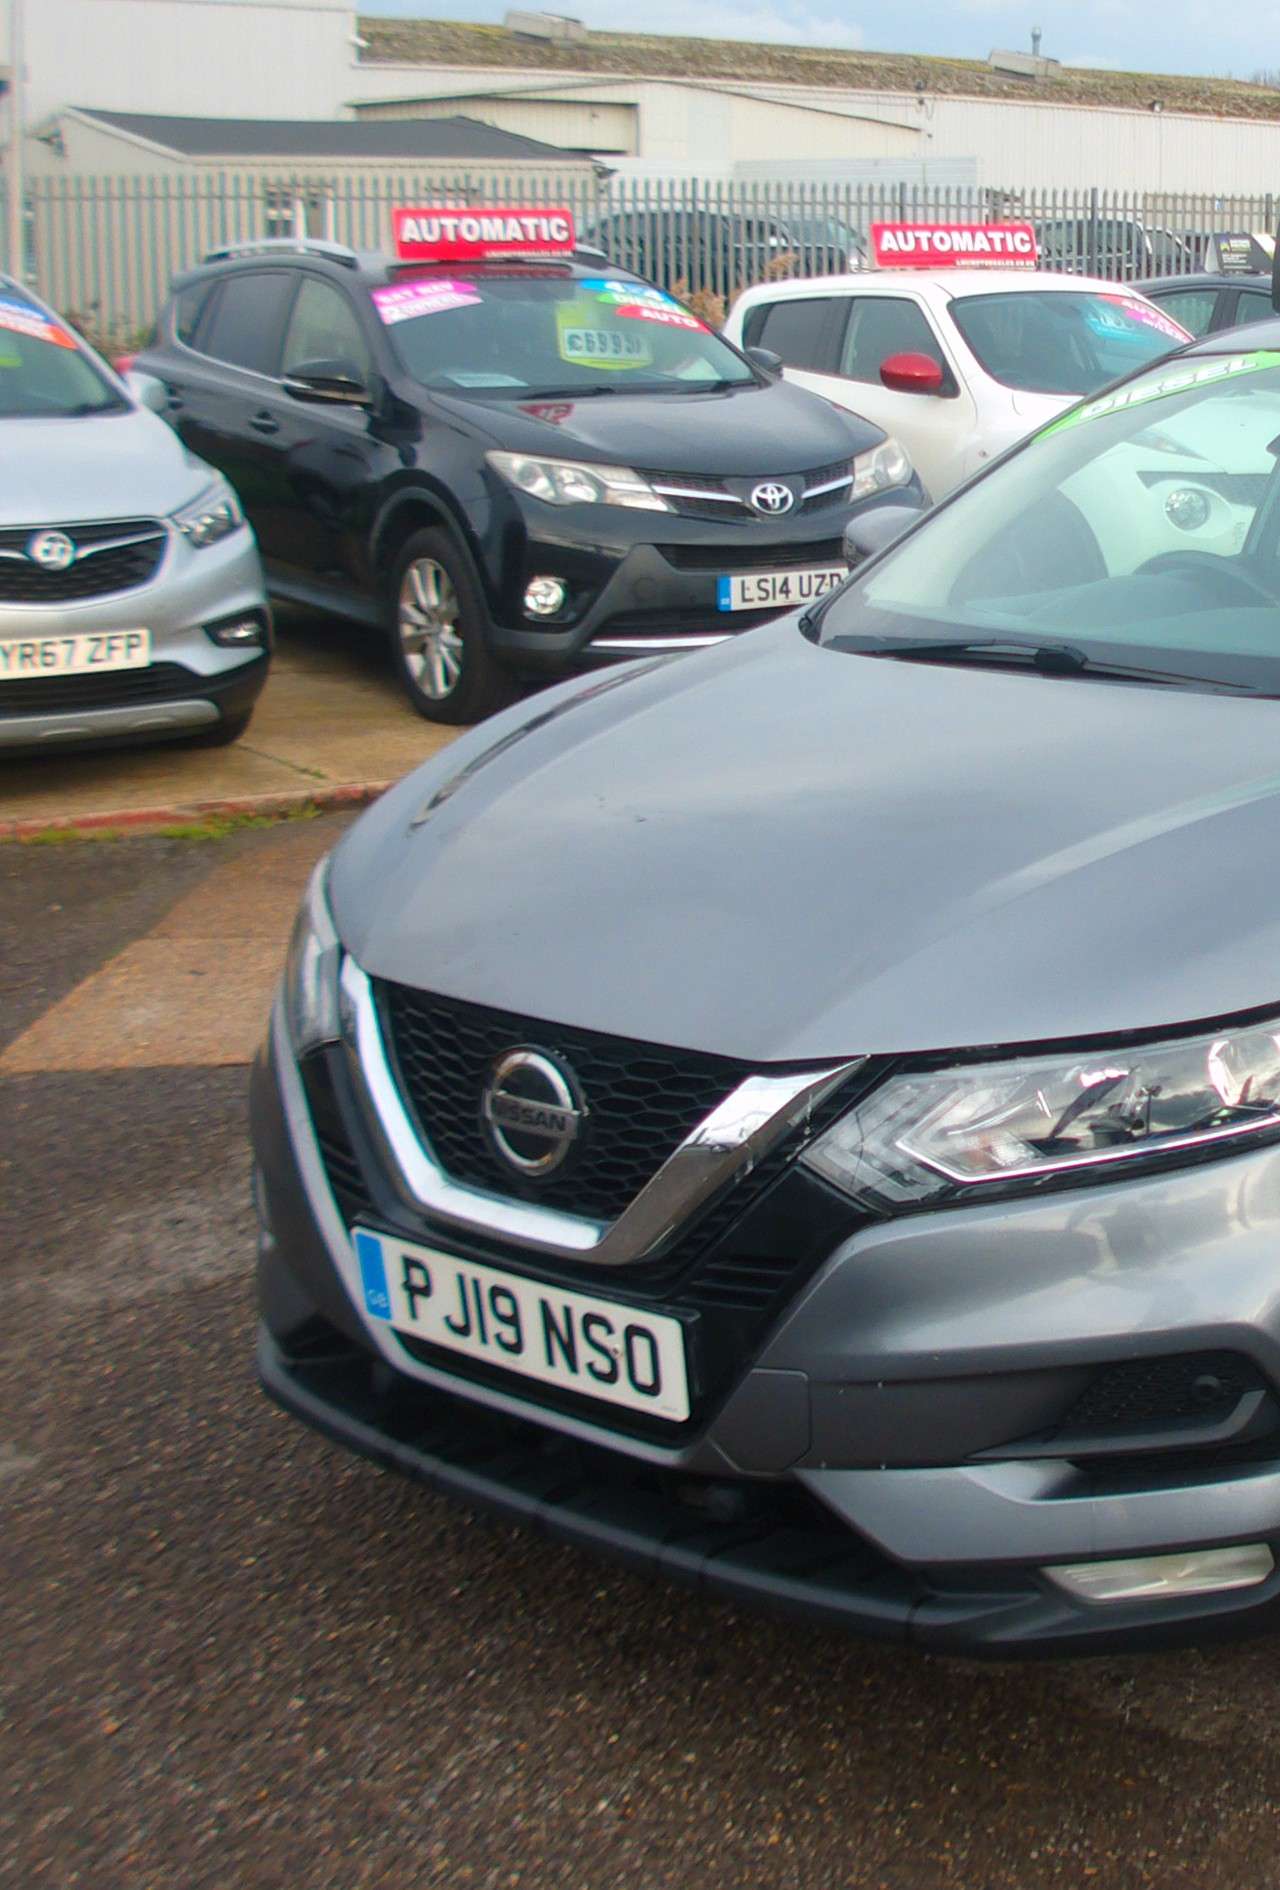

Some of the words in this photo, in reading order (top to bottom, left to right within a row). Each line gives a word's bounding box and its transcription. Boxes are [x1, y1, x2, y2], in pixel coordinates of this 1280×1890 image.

[402, 217, 569, 242] AUTOMATIC
[880, 231, 1031, 252] AUTOMATIC
[641, 308, 699, 328] AUTO
[1080, 359, 1257, 420] DIESEL
[740, 576, 792, 603] LS14
[0, 640, 76, 672] YR67
[87, 633, 141, 664] ZFP
[538, 1298, 661, 1397] NSO
